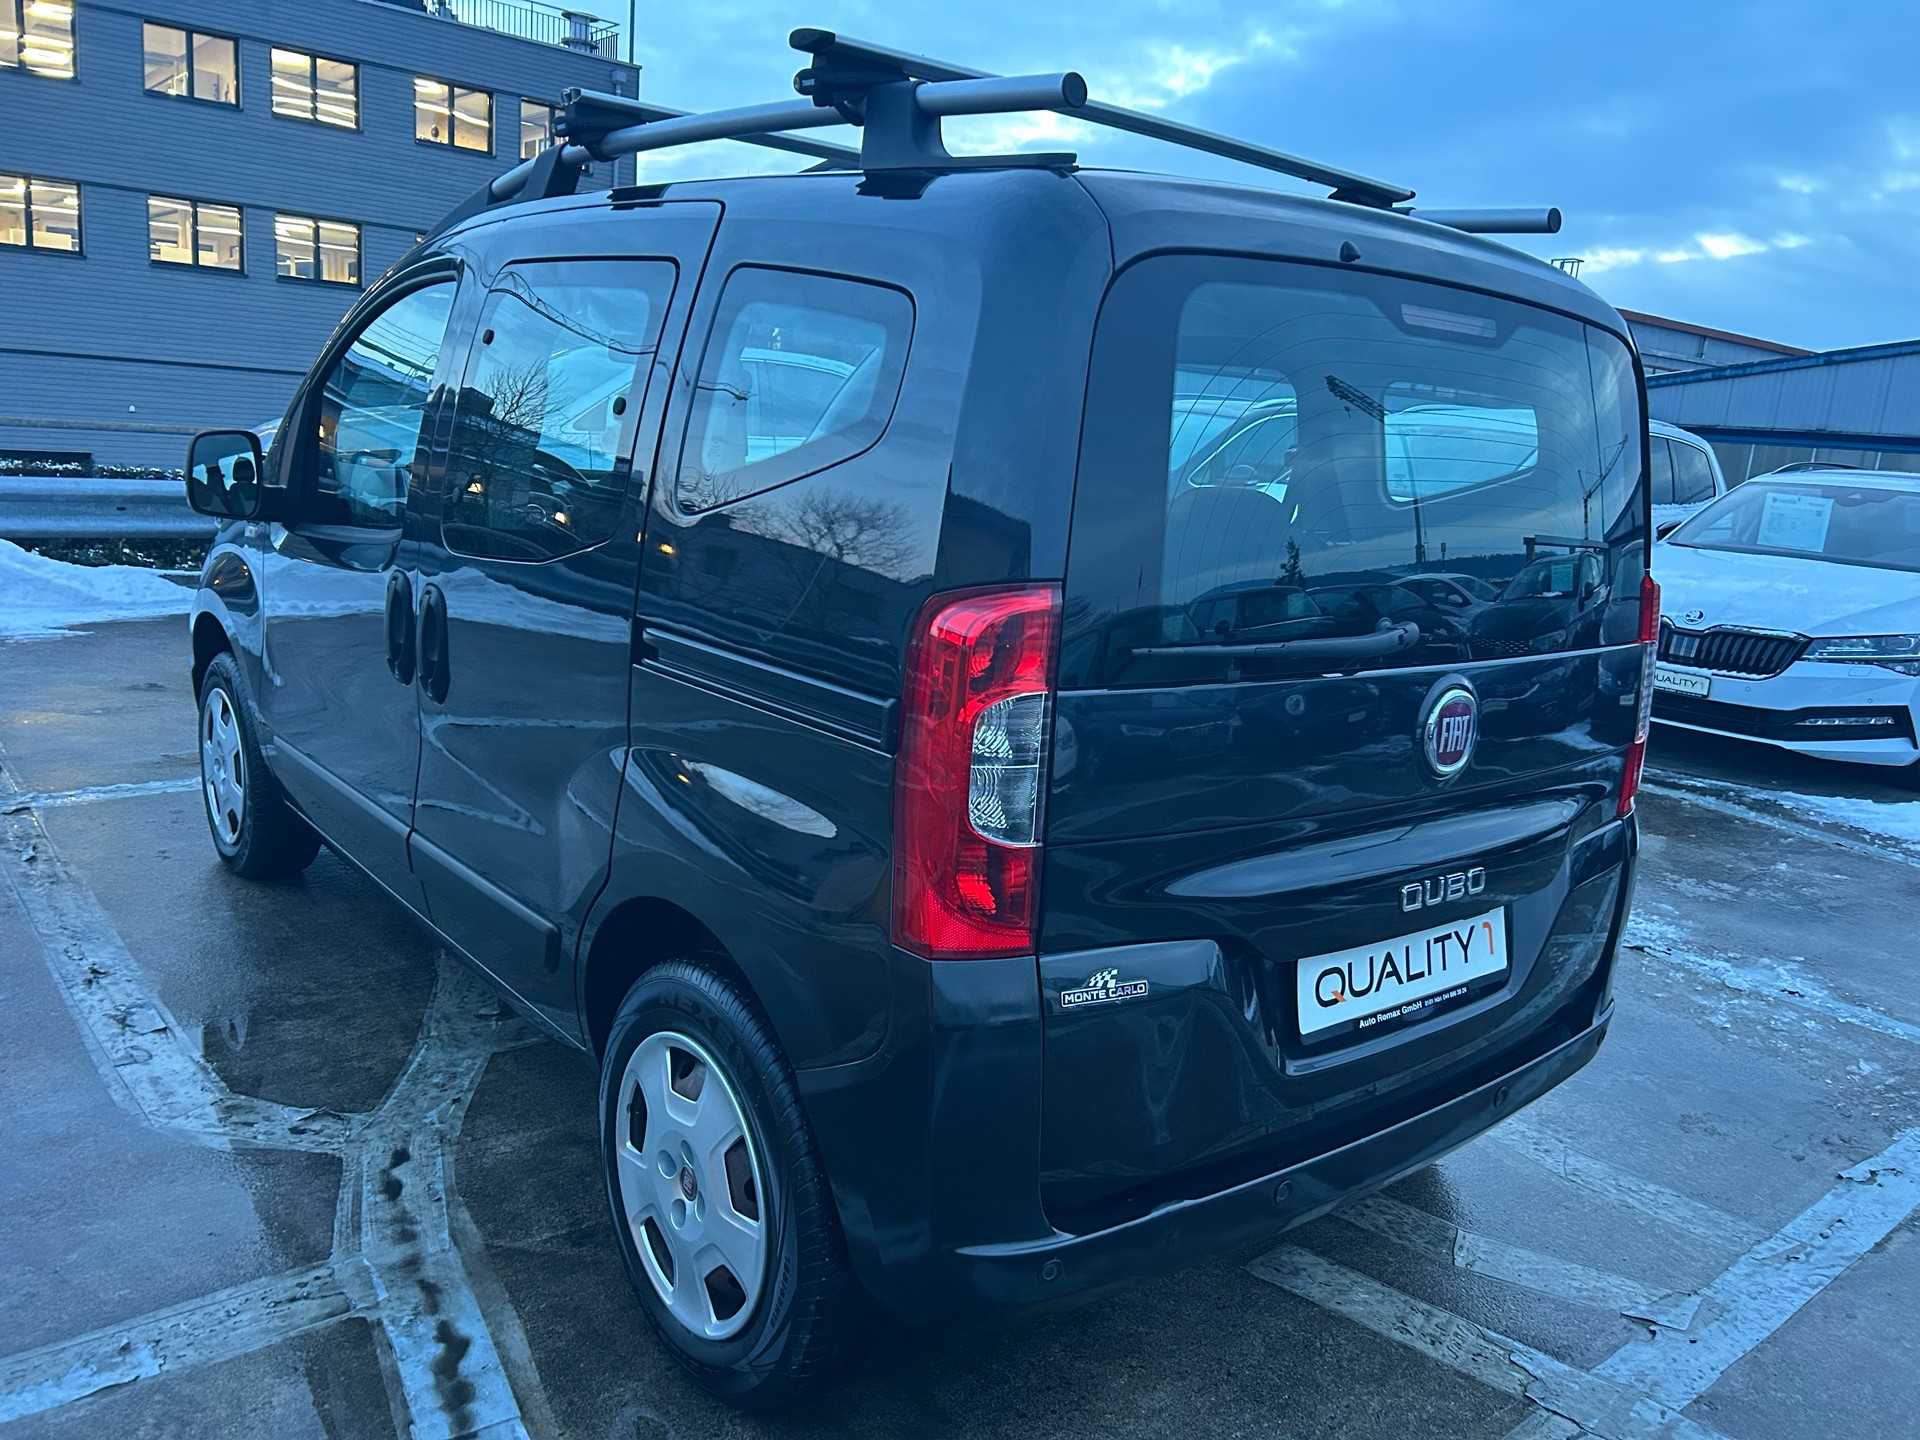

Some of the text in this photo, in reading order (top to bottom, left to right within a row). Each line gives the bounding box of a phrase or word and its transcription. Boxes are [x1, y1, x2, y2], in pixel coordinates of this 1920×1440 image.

[1655, 674, 1697, 688] UALITY
[1439, 715, 1470, 753] FIAT
[1401, 867, 1486, 912] QUBO
[1315, 925, 1475, 1008] QUALITY
[1064, 984, 1145, 1003] MONTE CARLO
[1359, 1017, 1376, 1029] Auto
[1377, 1009, 1401, 1023] Remax
[1401, 1000, 1422, 1014] GmbH
